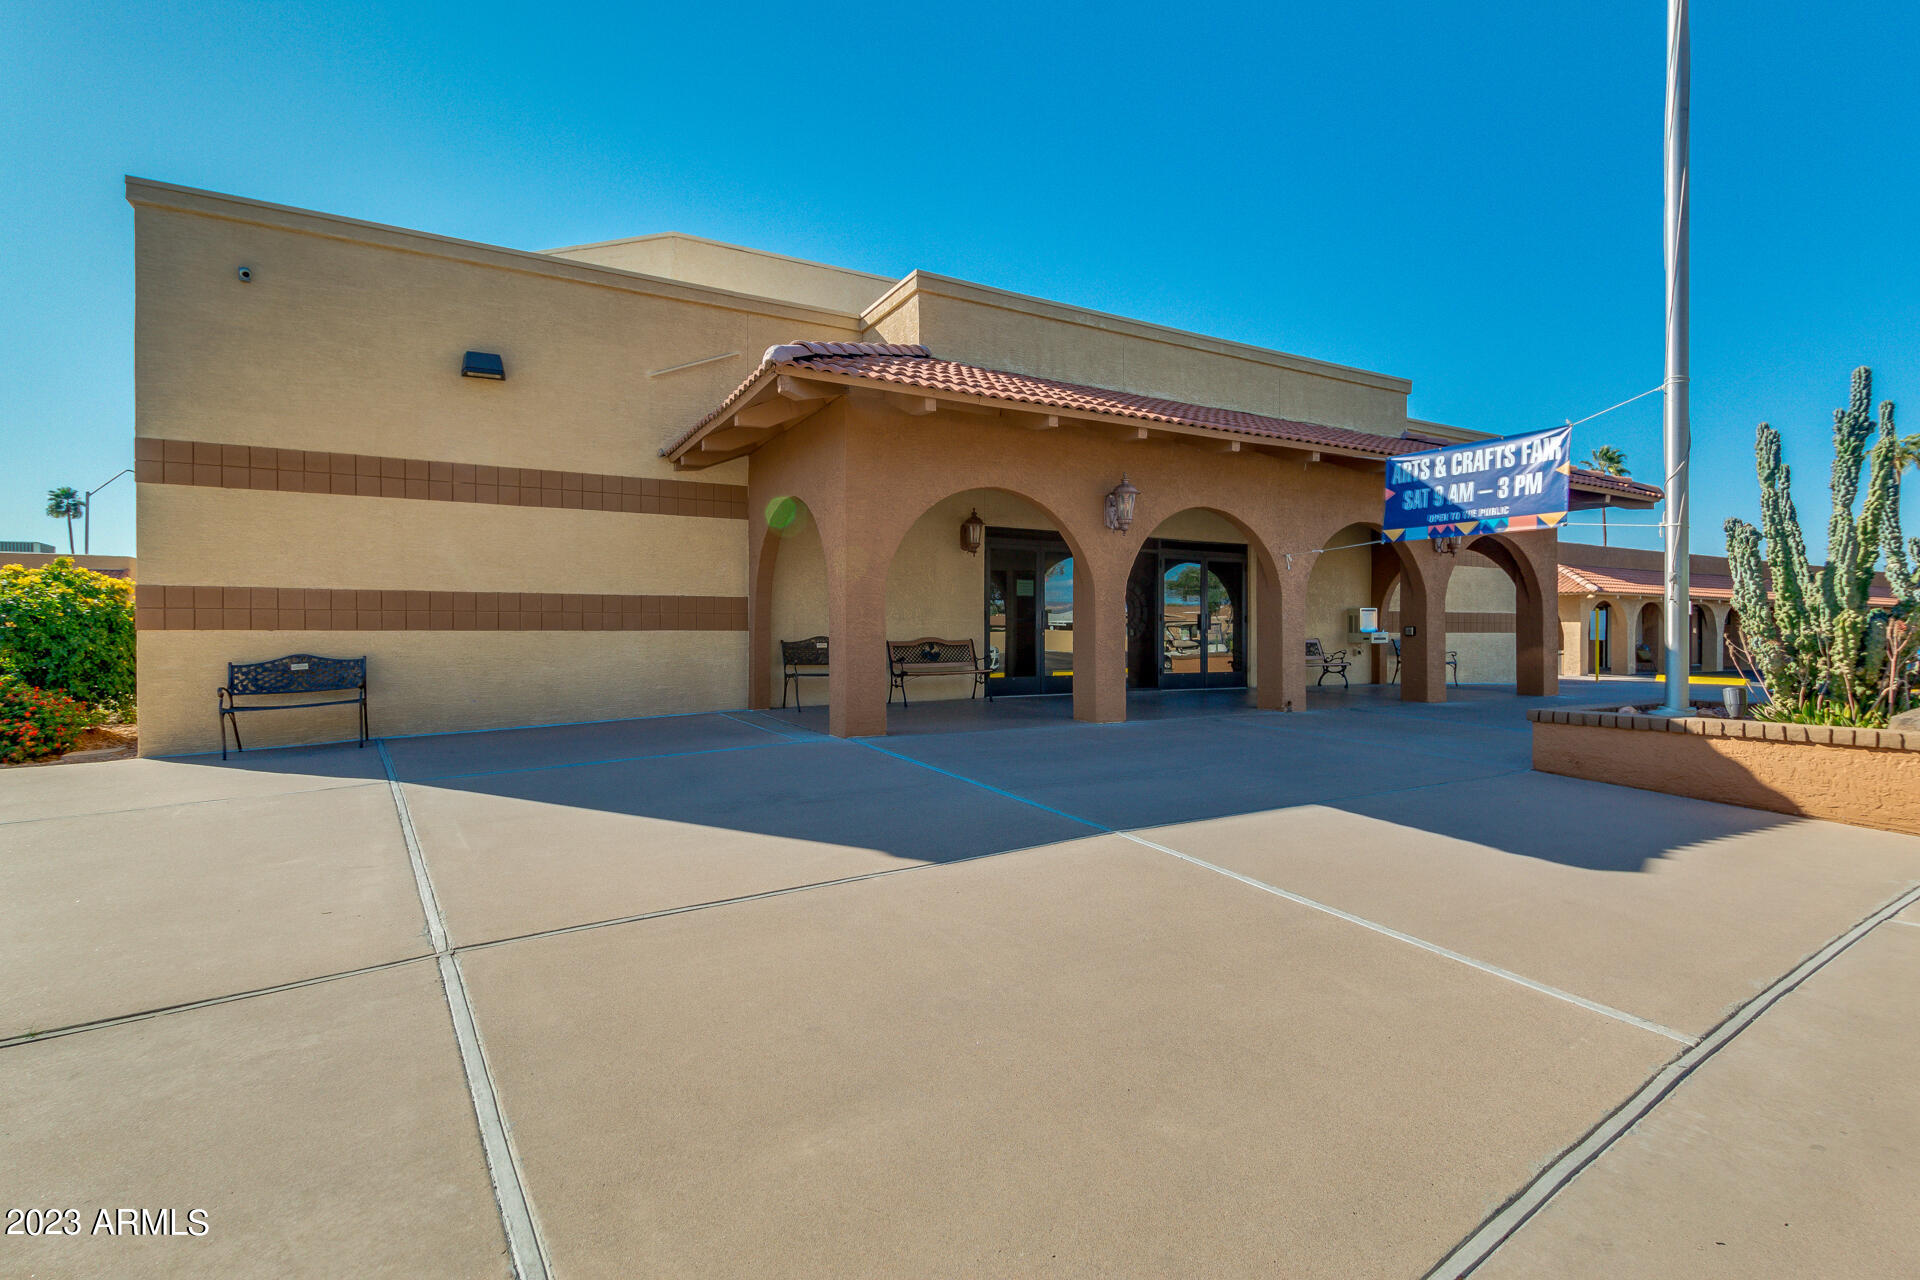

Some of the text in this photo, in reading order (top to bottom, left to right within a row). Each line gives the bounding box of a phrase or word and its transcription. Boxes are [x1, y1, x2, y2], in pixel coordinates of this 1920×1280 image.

[1392, 458, 1431, 485] ARTS
[1434, 455, 1447, 479] &
[1452, 444, 1516, 475] CRAFTS
[1403, 488, 1431, 510] SAT
[1434, 486, 1445, 506] 9
[1447, 481, 1475, 504] AM
[1497, 477, 1508, 498] 3
[1514, 472, 1542, 496] PM
[1428, 513, 1449, 523] OPEN
[1451, 511, 1461, 520] TO
[1478, 506, 1509, 517] PUBLIC
